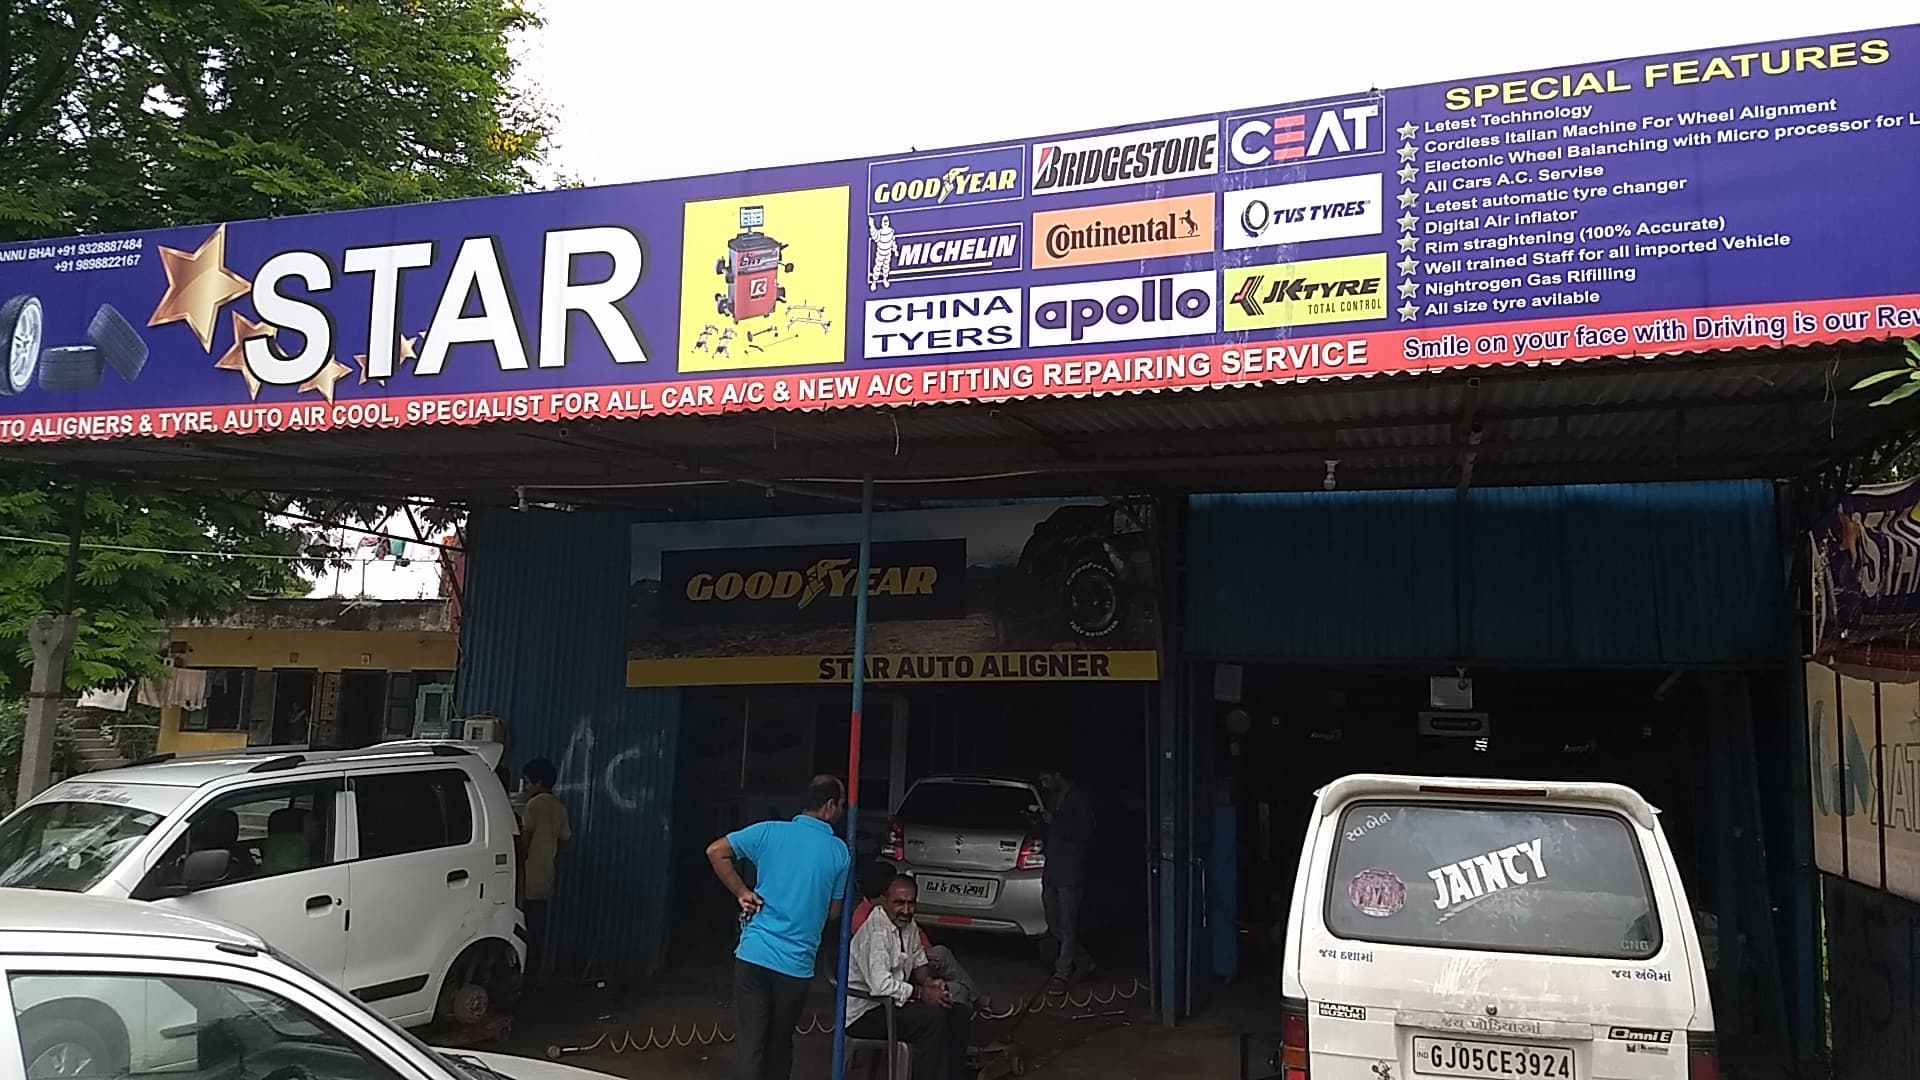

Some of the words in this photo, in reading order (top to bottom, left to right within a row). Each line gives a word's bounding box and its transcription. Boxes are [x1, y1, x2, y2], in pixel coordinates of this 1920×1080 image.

[1445, 70, 1632, 110] SPECIAL
[1645, 39, 1890, 88] FEATURES
[1231, 104, 1379, 165] CEAT
[1424, 115, 1477, 134] Letest
[1481, 104, 1593, 127] Techhnology
[1424, 134, 1501, 153] Cordless
[1505, 128, 1558, 144] Italian
[1563, 120, 1638, 138] Machine
[1642, 116, 1674, 129] For
[1677, 108, 1735, 125] Wheel
[1740, 98, 1838, 120] Alignment
[1425, 153, 1504, 173] Electonic
[1508, 146, 1562, 164] Wheel
[1567, 138, 1668, 158] Balanching
[1673, 131, 1712, 147] with
[1717, 126, 1769, 143] Micro
[1775, 119, 1871, 140] processor
[1875, 114, 1905, 128] for
[1034, 134, 1217, 190] BRIDGESTONE
[1424, 180, 1447, 194] All
[1452, 177, 1492, 190] Cars
[1496, 172, 1533, 186] A.C.
[1538, 165, 1604, 182] Servise
[1425, 198, 1478, 214] Letest
[1482, 189, 1568, 208] automatic
[1572, 185, 1608, 201] tyre
[1612, 178, 1688, 196] changer
[1274, 207, 1307, 225] TVS
[1310, 200, 1366, 221] TYRES
[1425, 217, 1479, 235] Digital
[1484, 214, 1511, 228] Air
[1515, 209, 1578, 225] inflator
[898, 234, 1017, 267] MICHELIN
[1046, 213, 1177, 259] Continental
[1425, 241, 1459, 254] Rim
[1463, 231, 1575, 250] straghtening
[1579, 223, 1632, 243] (100%
[1636, 215, 1726, 236] Accurate)
[28, 246, 56, 260] BHAI
[57, 244, 76, 256] +91
[54, 260, 74, 272] +91
[1425, 260, 1462, 275] Well
[1466, 254, 1528, 271] trained
[1532, 249, 1574, 265] Staff
[1578, 248, 1605, 261] for
[1608, 245, 1630, 259] all
[1635, 238, 1717, 258] imported
[1722, 233, 1791, 250] Vehicle
[1425, 277, 1522, 296] Nightrogen
[1527, 273, 1562, 287] Gas
[1567, 267, 1636, 283] Rifilling
[244, 225, 649, 386] STAR
[874, 295, 1013, 323] CHINA
[1035, 278, 1211, 341] apollo
[1308, 303, 1336, 315] TOTAL
[1340, 298, 1382, 312] CONTROL
[1425, 303, 1448, 316] All
[1453, 299, 1488, 314] size
[1492, 297, 1527, 312] tyre
[1531, 290, 1601, 308] avilable
[872, 325, 1013, 353] TYERS
[1405, 336, 1469, 360] Smile
[1476, 336, 1507, 354] on
[1514, 331, 1569, 356] your
[1575, 325, 1628, 347] face
[1633, 318, 1686, 343] with
[1693, 312, 1786, 340] Driving
[1793, 311, 1816, 333] is
[1825, 310, 1869, 332] our
[30, 414, 133, 437] ALIGNERS
[138, 414, 152, 437] &
[223, 408, 282, 429] AUTO
[288, 406, 325, 427] AIR
[332, 403, 401, 425] COOL,
[406, 395, 544, 422] SPECIALIST
[550, 392, 600, 415] FOR
[606, 390, 654, 412] ALL
[661, 385, 714, 408] CAR
[721, 382, 765, 405] A/C
[772, 380, 791, 402] &
[799, 375, 860, 400] NEW
[867, 373, 913, 398] A/C
[922, 366, 1034, 393] FITTING
[1043, 353, 1211, 386] REPAIRING
[1221, 339, 1368, 374] SERVICE
[896, 655, 974, 680] AUTO
[980, 654, 1110, 679] ALIGNER
[1427, 838, 1548, 910] JAINCY
[1620, 939, 1649, 951] CNG
[1320, 1003, 1365, 1014] MARUTI
[1320, 1009, 1365, 1020] SUZUKI
[1417, 1050, 1429, 1060] IND
[1431, 1044, 1570, 1079] GJ05CE3924
